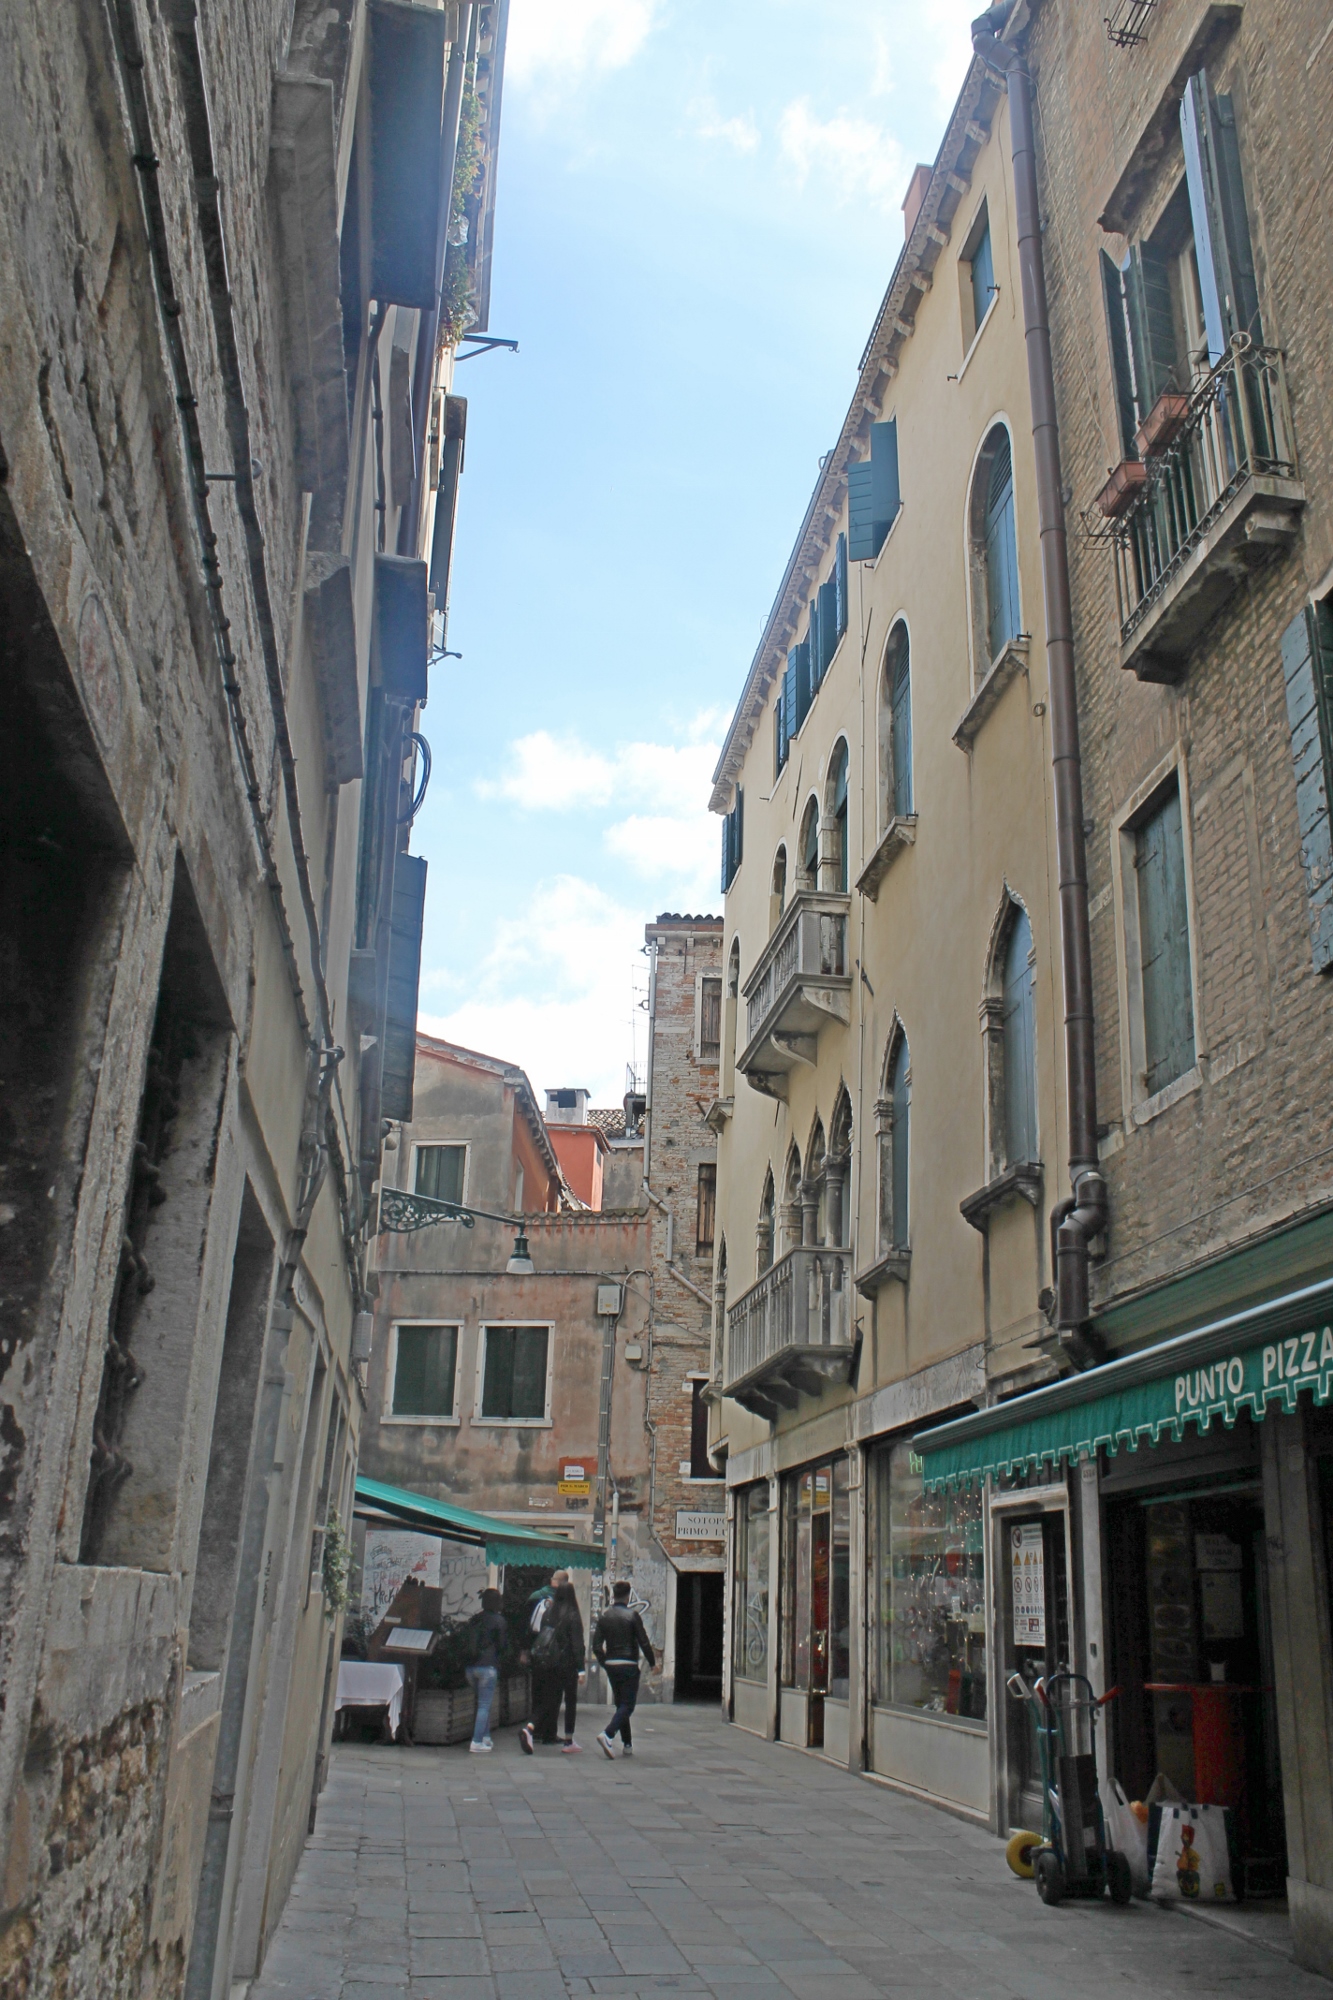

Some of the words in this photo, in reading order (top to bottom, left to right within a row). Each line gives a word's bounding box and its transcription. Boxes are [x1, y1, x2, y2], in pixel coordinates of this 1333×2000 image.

[1175, 1357, 1244, 1413] PUNTO
[1263, 1326, 1333, 1387] PIZZA
[677, 1527, 709, 1536] PRIMO
